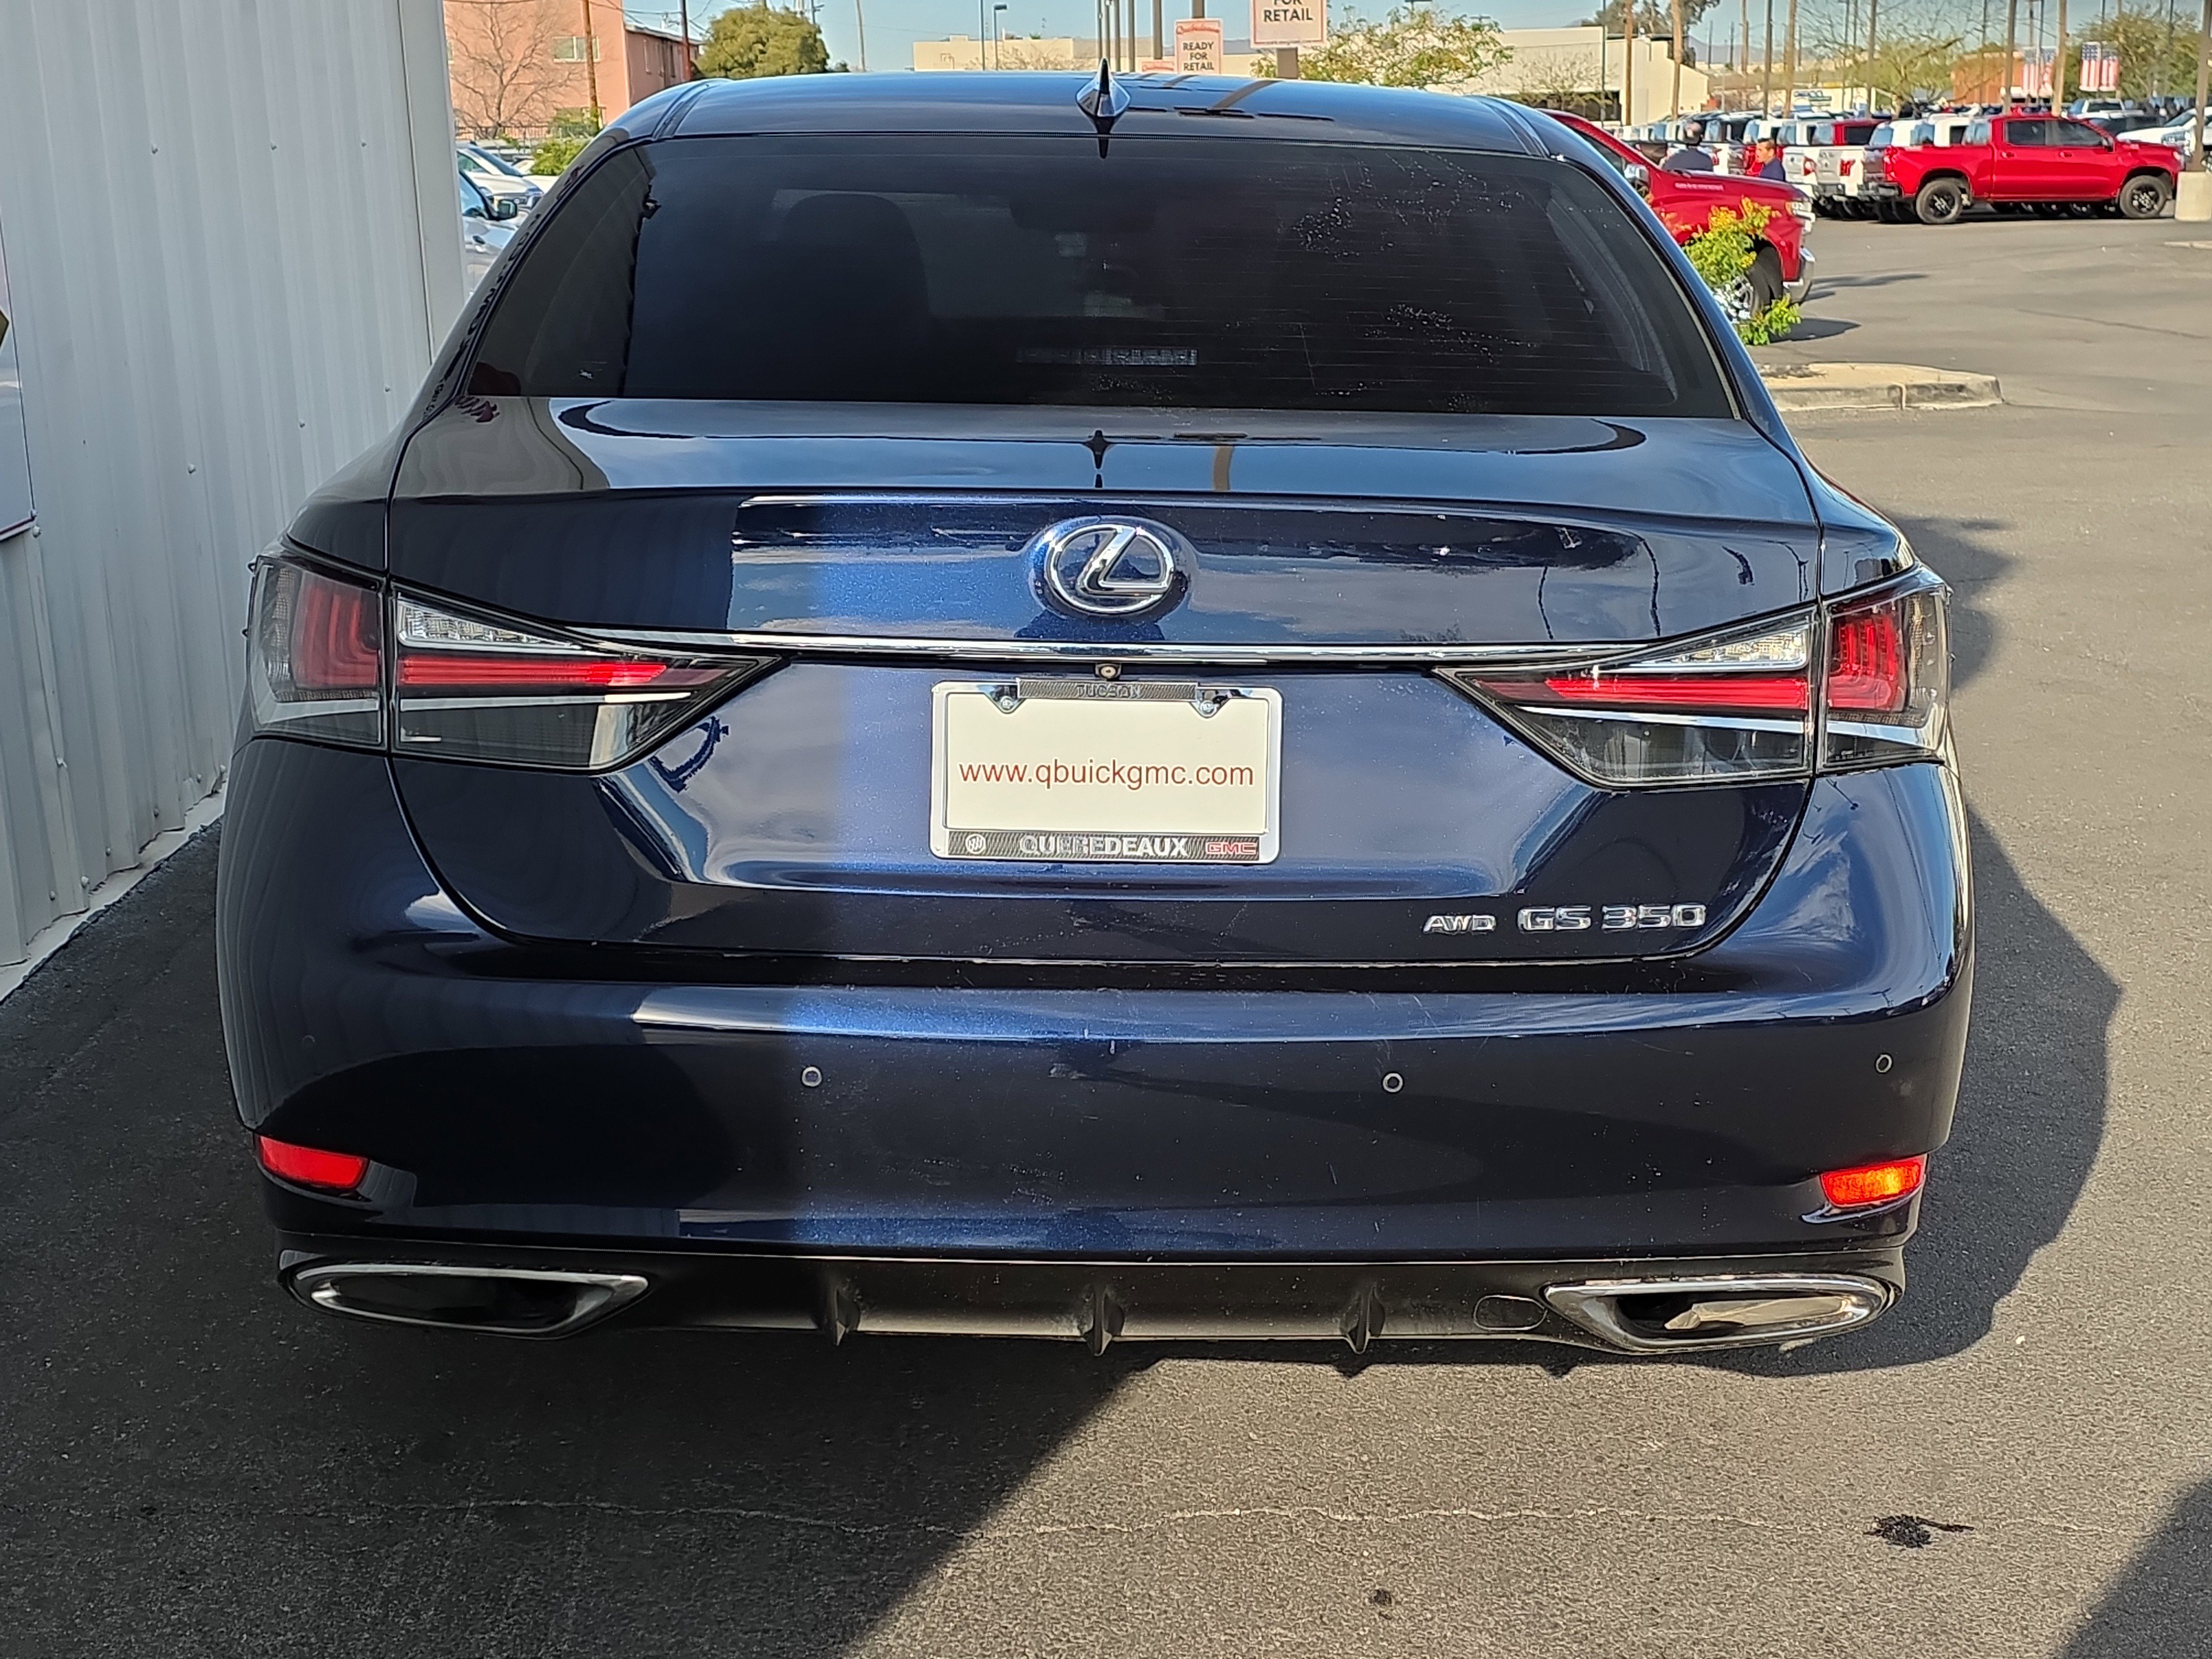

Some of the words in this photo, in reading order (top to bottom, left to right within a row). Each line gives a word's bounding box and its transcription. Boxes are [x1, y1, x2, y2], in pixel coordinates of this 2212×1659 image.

[1263, 8, 1313, 22] RETAIL
[1182, 41, 1214, 51] READY
[1189, 52, 1207, 61] FOR
[1183, 62, 1214, 71] RETAIL
[959, 759, 1253, 790] www.qbuickgmc.com
[1205, 841, 1257, 856] GMC
[1518, 905, 1591, 931] GS
[1600, 904, 1707, 930] 350
[1423, 915, 1496, 935] AWD
